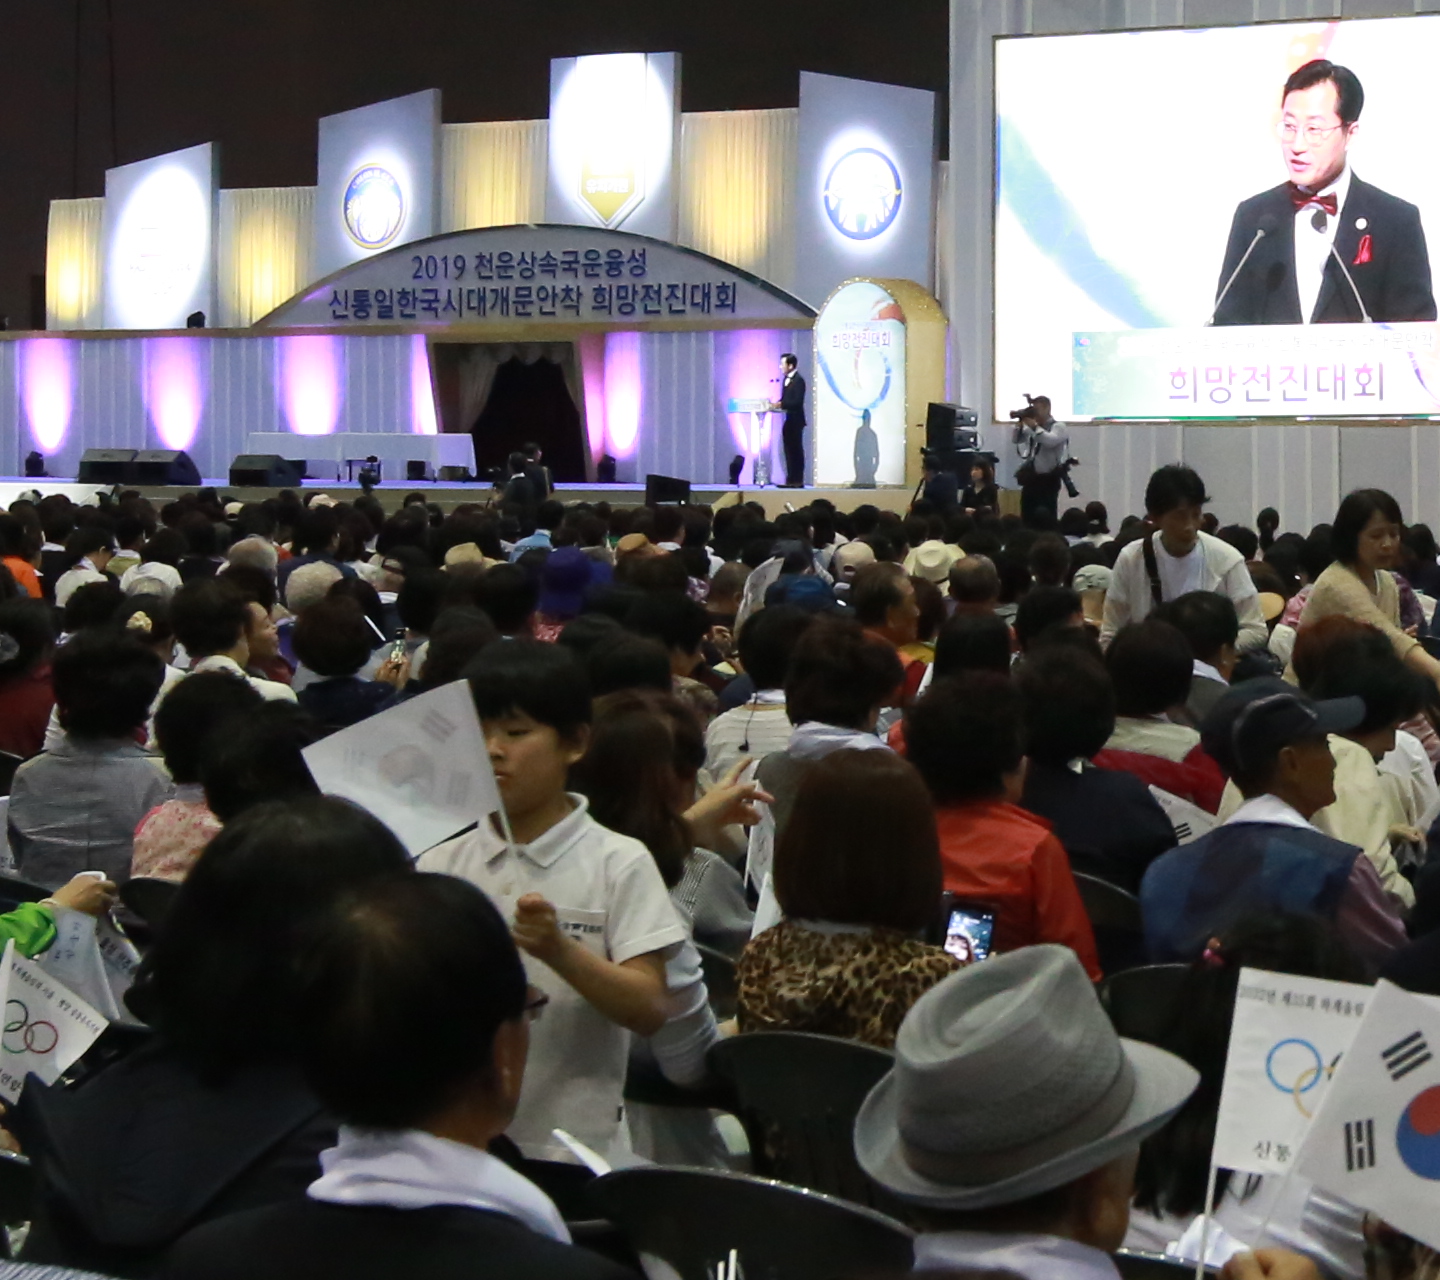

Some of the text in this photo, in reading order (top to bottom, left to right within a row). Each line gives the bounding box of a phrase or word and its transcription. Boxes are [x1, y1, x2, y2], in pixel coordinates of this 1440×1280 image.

[412, 253, 466, 281] 2019
[328, 281, 737, 319] 신통일한국시대개문안착 희망전진대회
[1168, 361, 1384, 404] 희망전진대회
